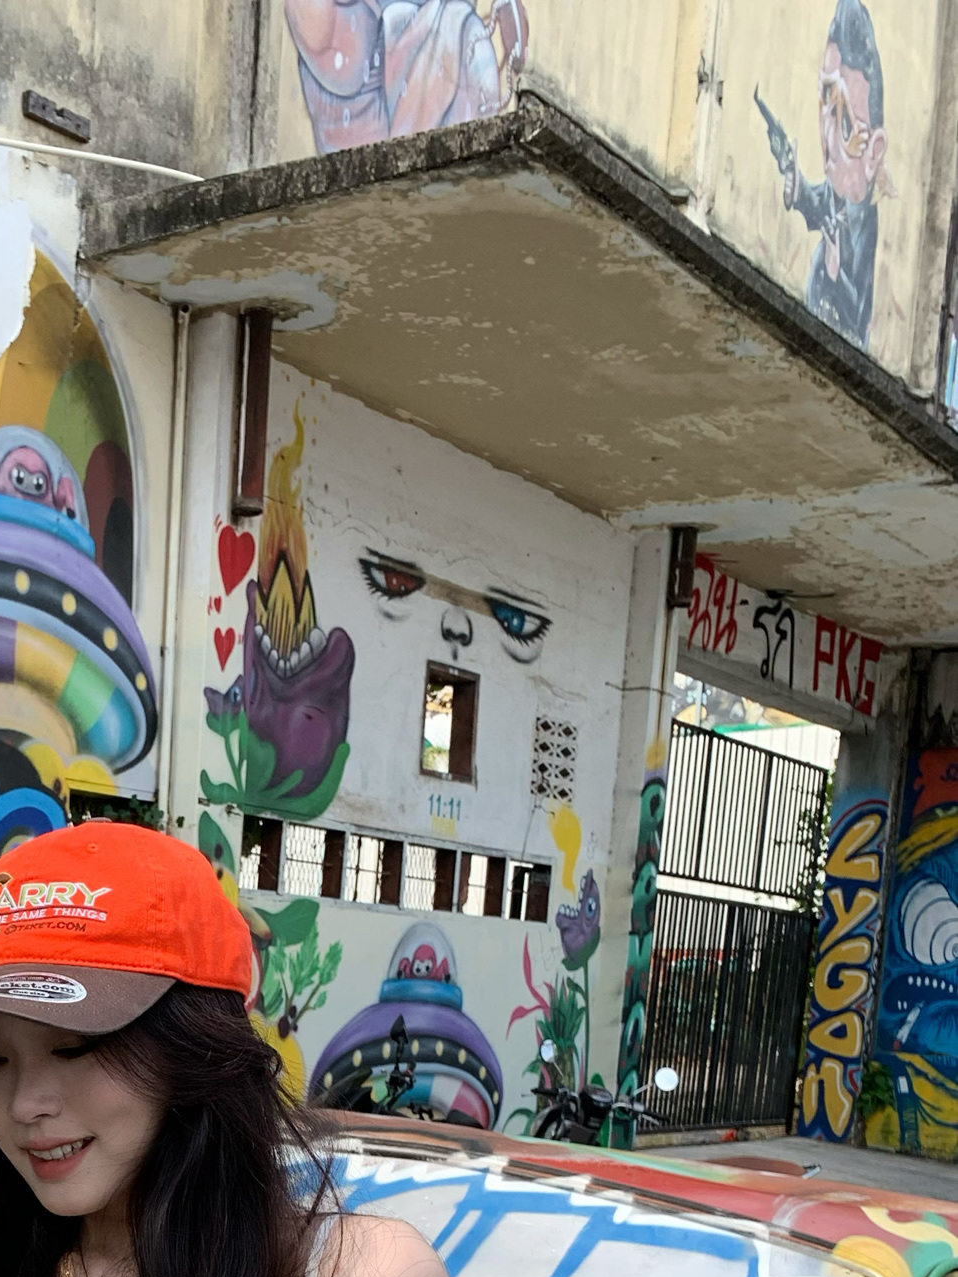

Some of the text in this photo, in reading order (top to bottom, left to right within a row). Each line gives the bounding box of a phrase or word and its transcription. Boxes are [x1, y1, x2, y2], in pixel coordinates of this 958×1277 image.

[428, 793, 461, 821] 11:11
[12, 908, 48, 922] SAME
[53, 907, 108, 922] THINGS
